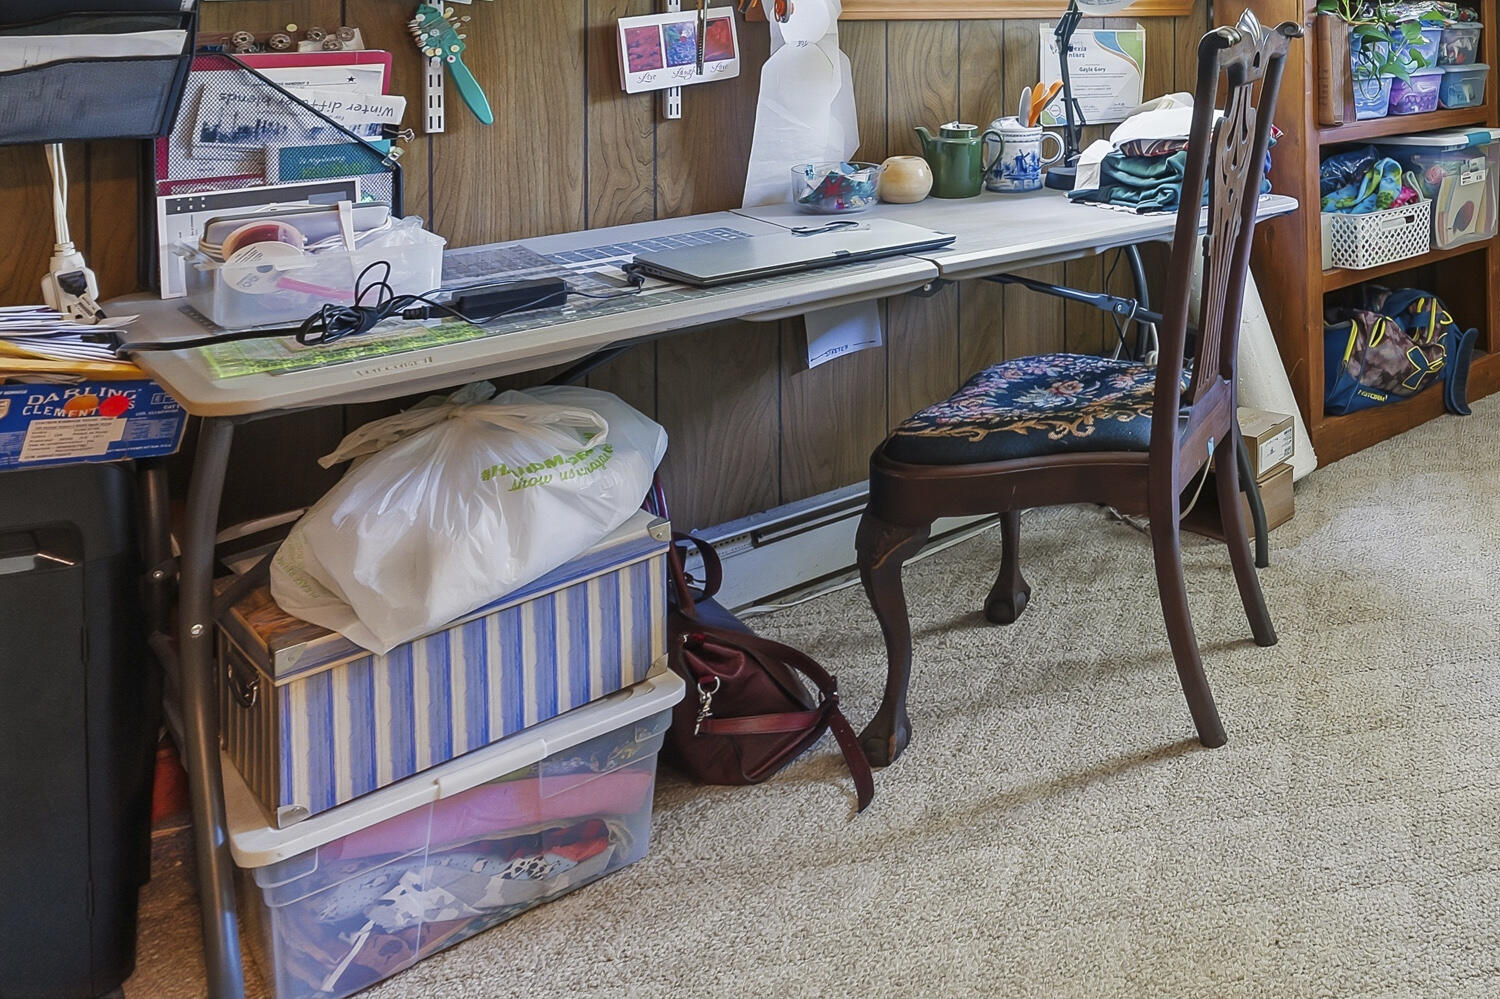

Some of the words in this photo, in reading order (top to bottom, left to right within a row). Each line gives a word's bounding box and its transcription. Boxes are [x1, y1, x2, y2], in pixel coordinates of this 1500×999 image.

[346, 103, 394, 117] Winter
[27, 386, 137, 405] DARLING
[22, 400, 135, 417] CLEMENTS
